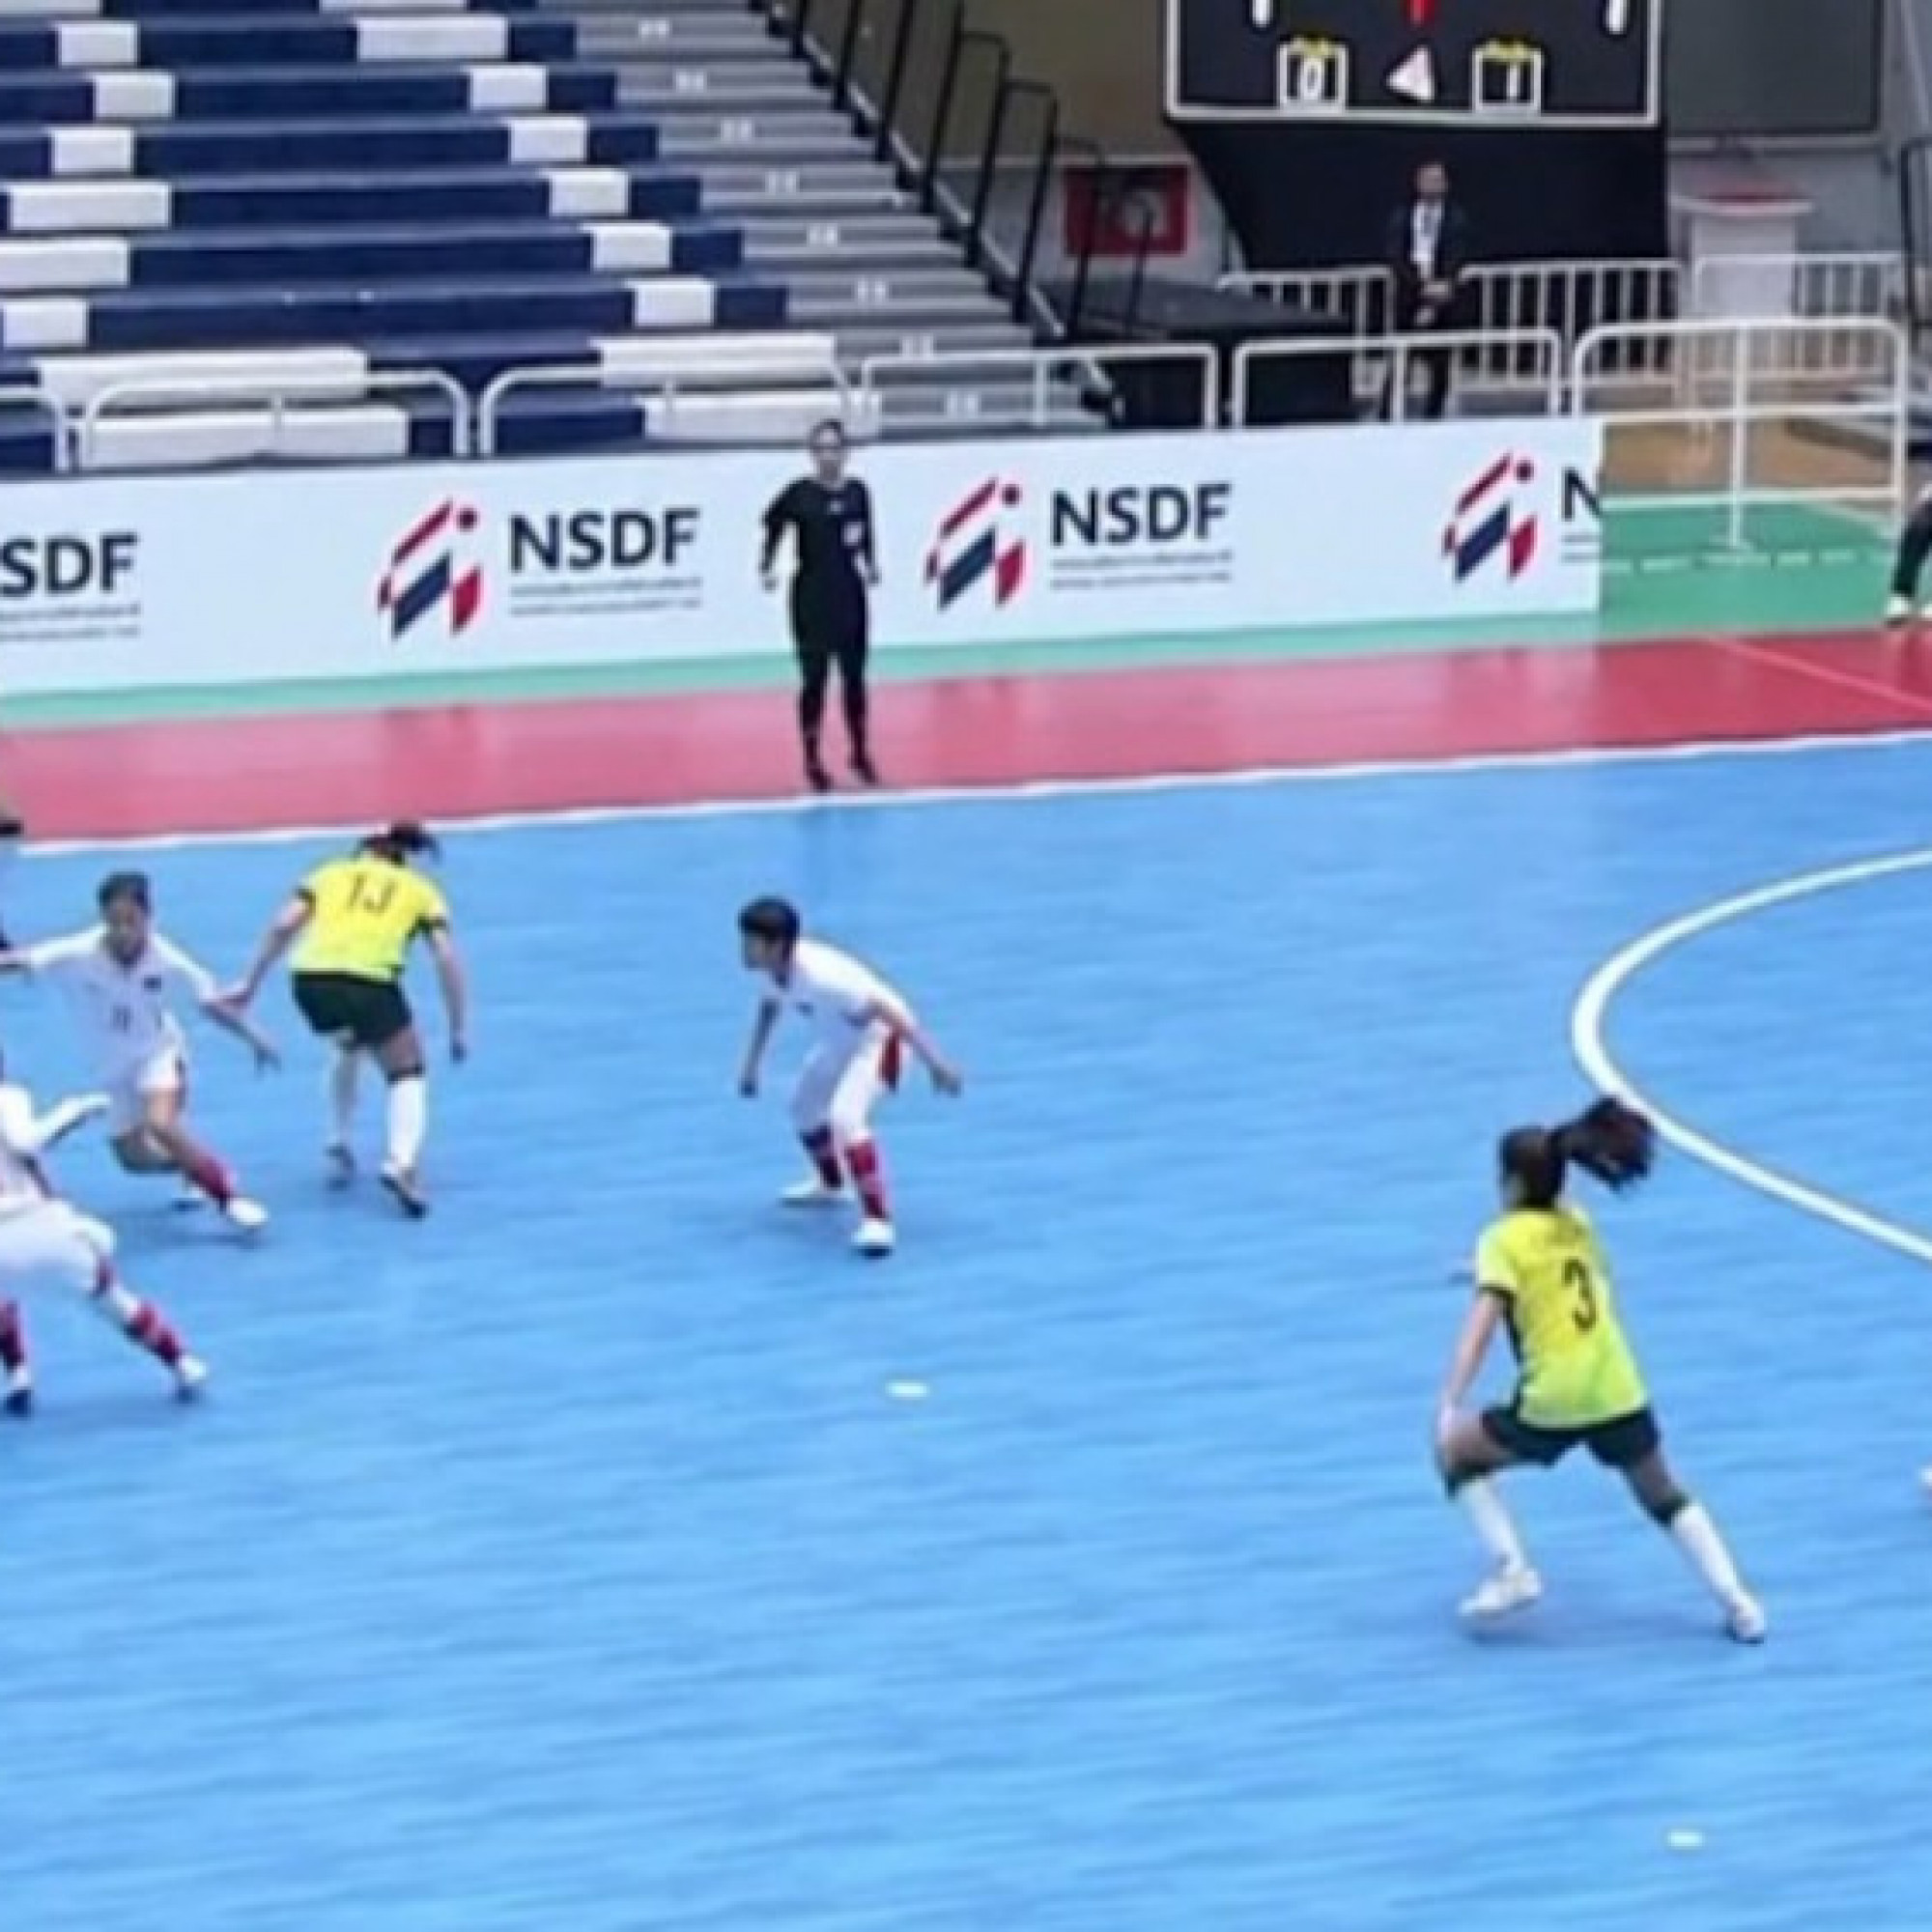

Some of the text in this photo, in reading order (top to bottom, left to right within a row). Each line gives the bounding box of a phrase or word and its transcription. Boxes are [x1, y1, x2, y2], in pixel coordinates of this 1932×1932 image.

[509, 505, 701, 574] NSDF
[1050, 481, 1233, 548] NSDF
[1562, 1258, 1599, 1332] 3
